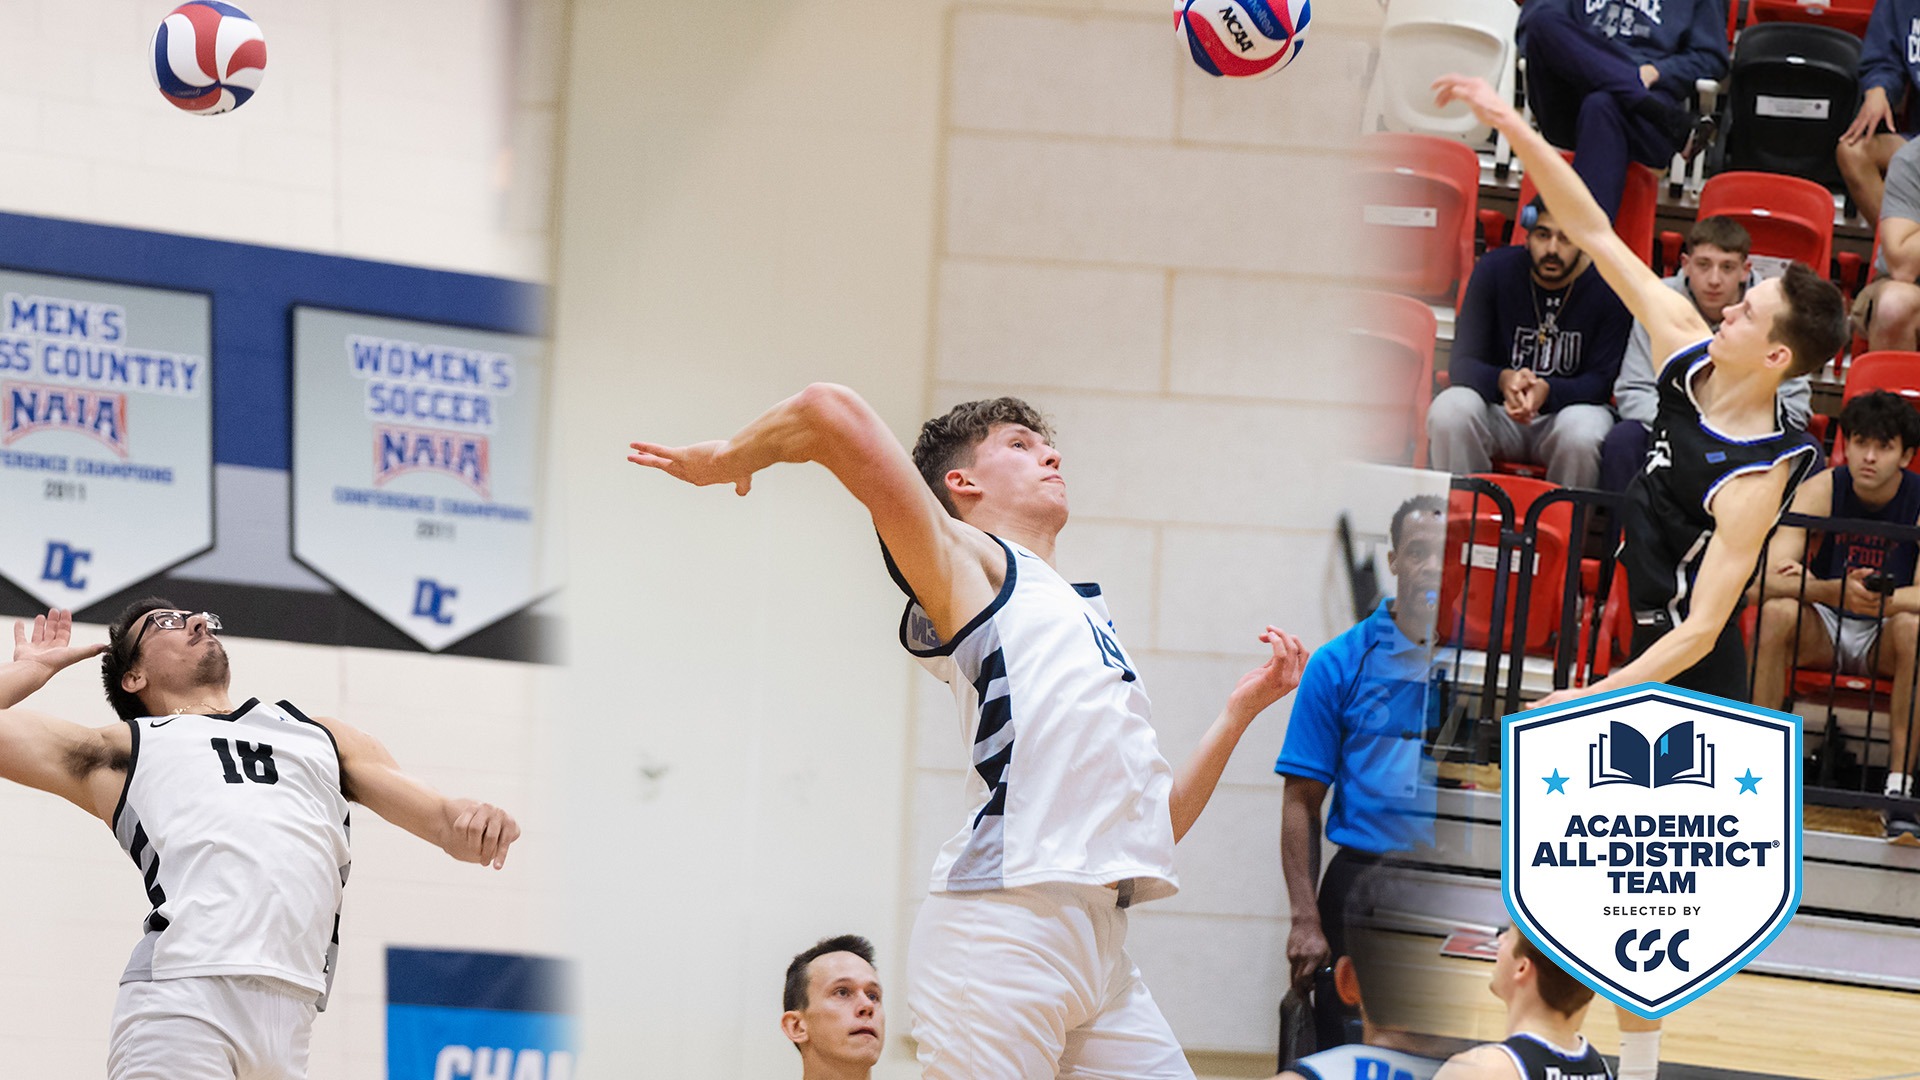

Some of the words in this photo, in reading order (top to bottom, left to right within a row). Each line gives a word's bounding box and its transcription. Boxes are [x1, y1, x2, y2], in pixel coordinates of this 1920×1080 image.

[1218, 6, 1255, 52] NCAA
[44, 345, 197, 390] COUNTRY
[1511, 326, 1582, 376] FDU
[10, 389, 119, 441] NAIA
[369, 383, 492, 425] SOCCER
[380, 430, 483, 486] NAIA
[41, 540, 91, 590] DC
[1848, 545, 1885, 567] FDU
[411, 577, 459, 625] DC
[210, 737, 279, 785] 18
